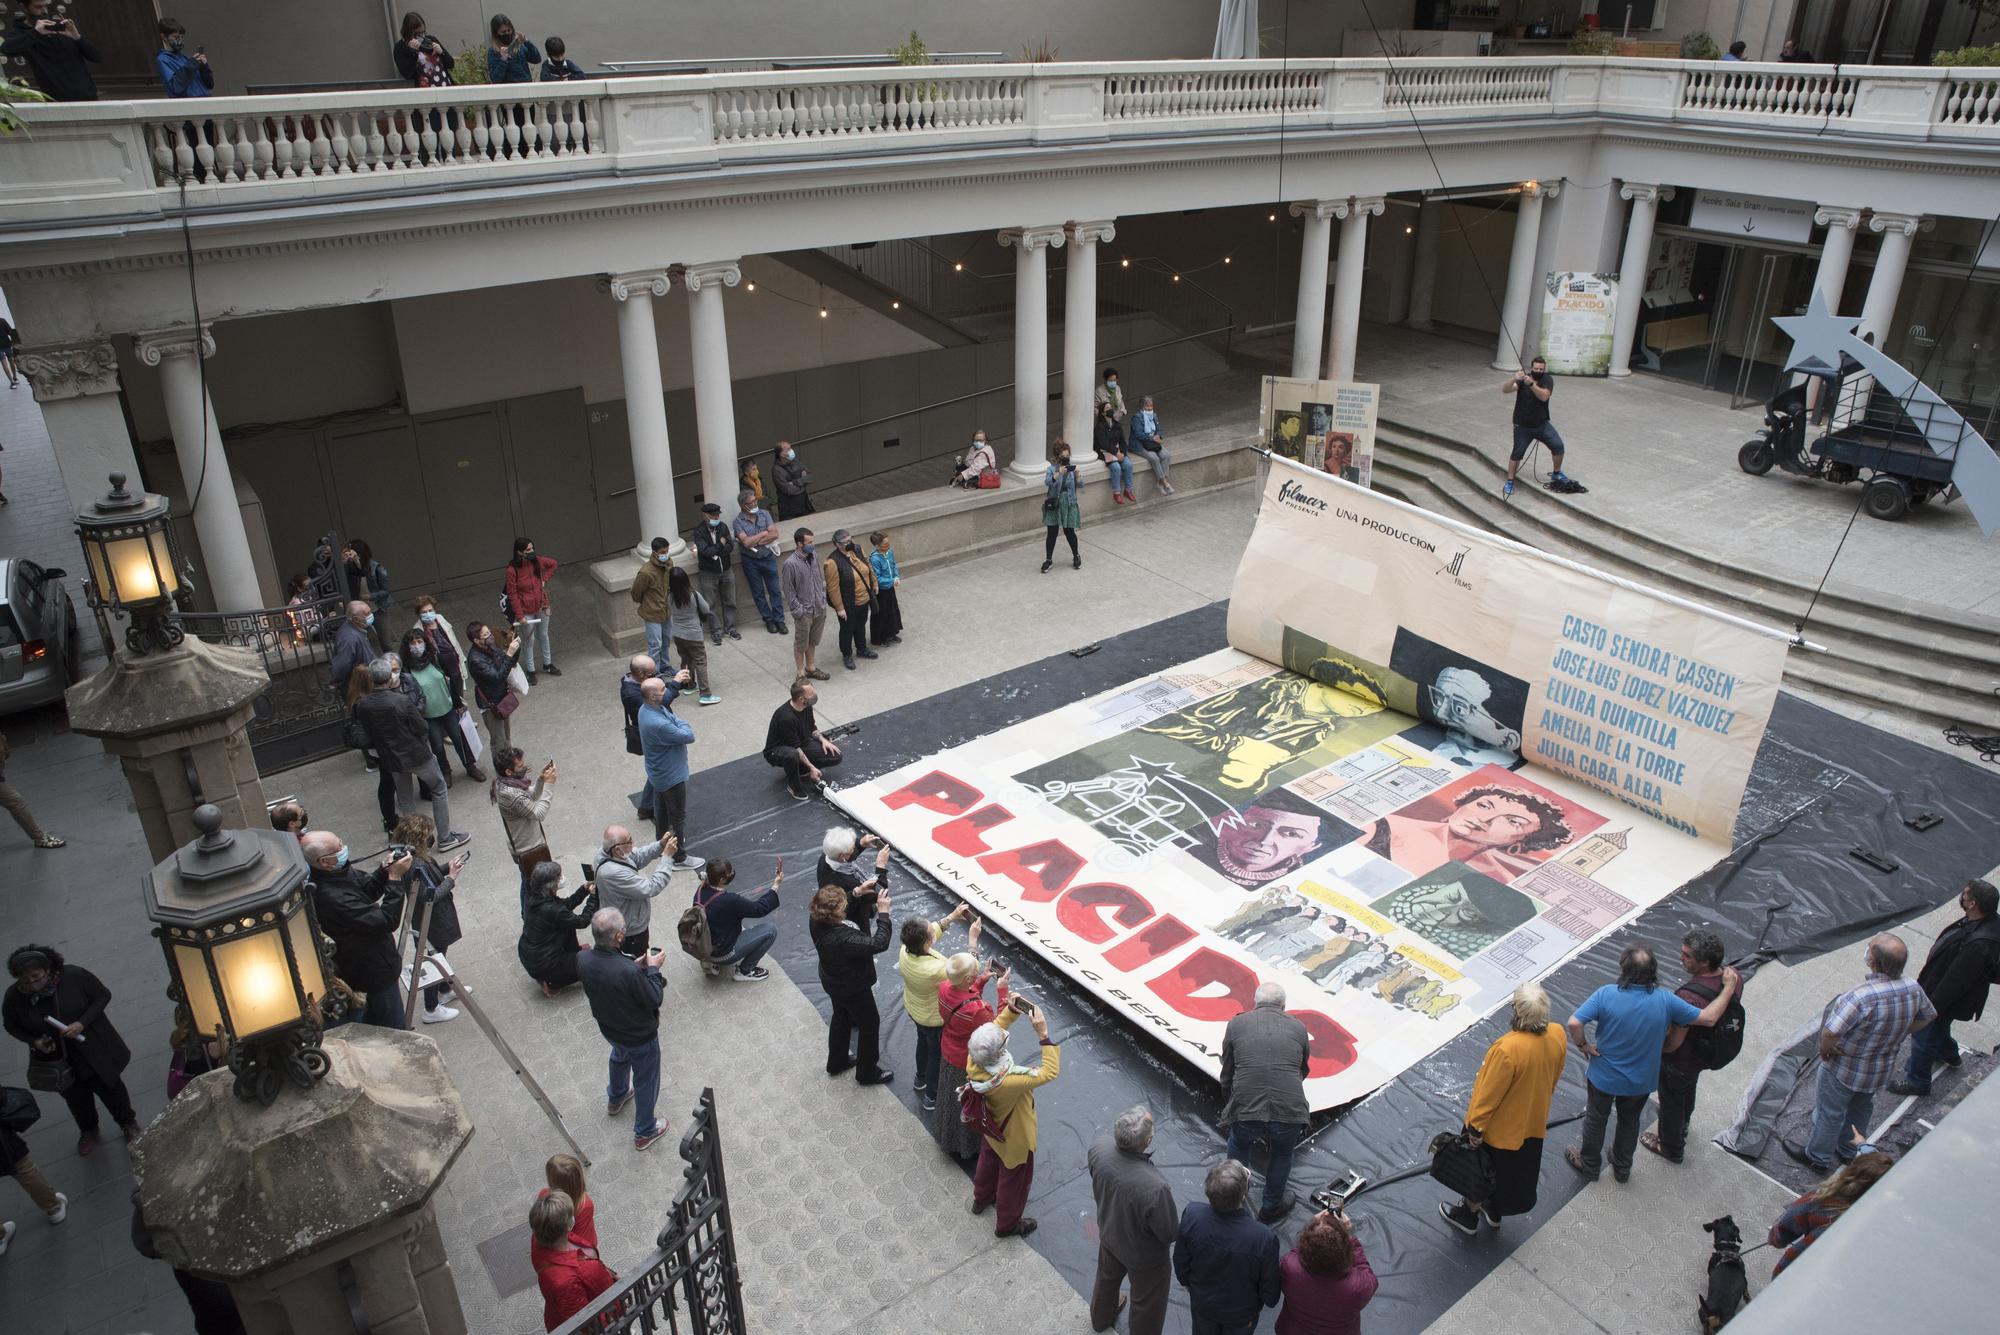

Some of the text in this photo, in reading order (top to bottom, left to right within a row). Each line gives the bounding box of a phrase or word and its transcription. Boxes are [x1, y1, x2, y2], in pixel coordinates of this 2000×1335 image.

[1285, 501, 1319, 517] PRESENTA
[1336, 507, 1436, 554] UNA PRODUCCION
[1454, 577, 1472, 590] FILMS
[1562, 614, 1608, 652] CASTO
[1609, 633, 1671, 677] SENDRA
[1546, 677, 1678, 750] ELVIRA QUINTILLA
[1553, 648, 1735, 735] JOSE LUIS LOPEZ VAZQUEZ
[1536, 737, 1663, 806] JULIA CABA ALBA
[1540, 709, 1686, 786] AMELIA DE LA TORRE
[877, 770, 1358, 1079] PLACIDO
[937, 862, 964, 881] UN
[966, 883, 1007, 911] FILM
[1009, 912, 1041, 931] DE
[1107, 989, 1224, 1066] BERLAN
